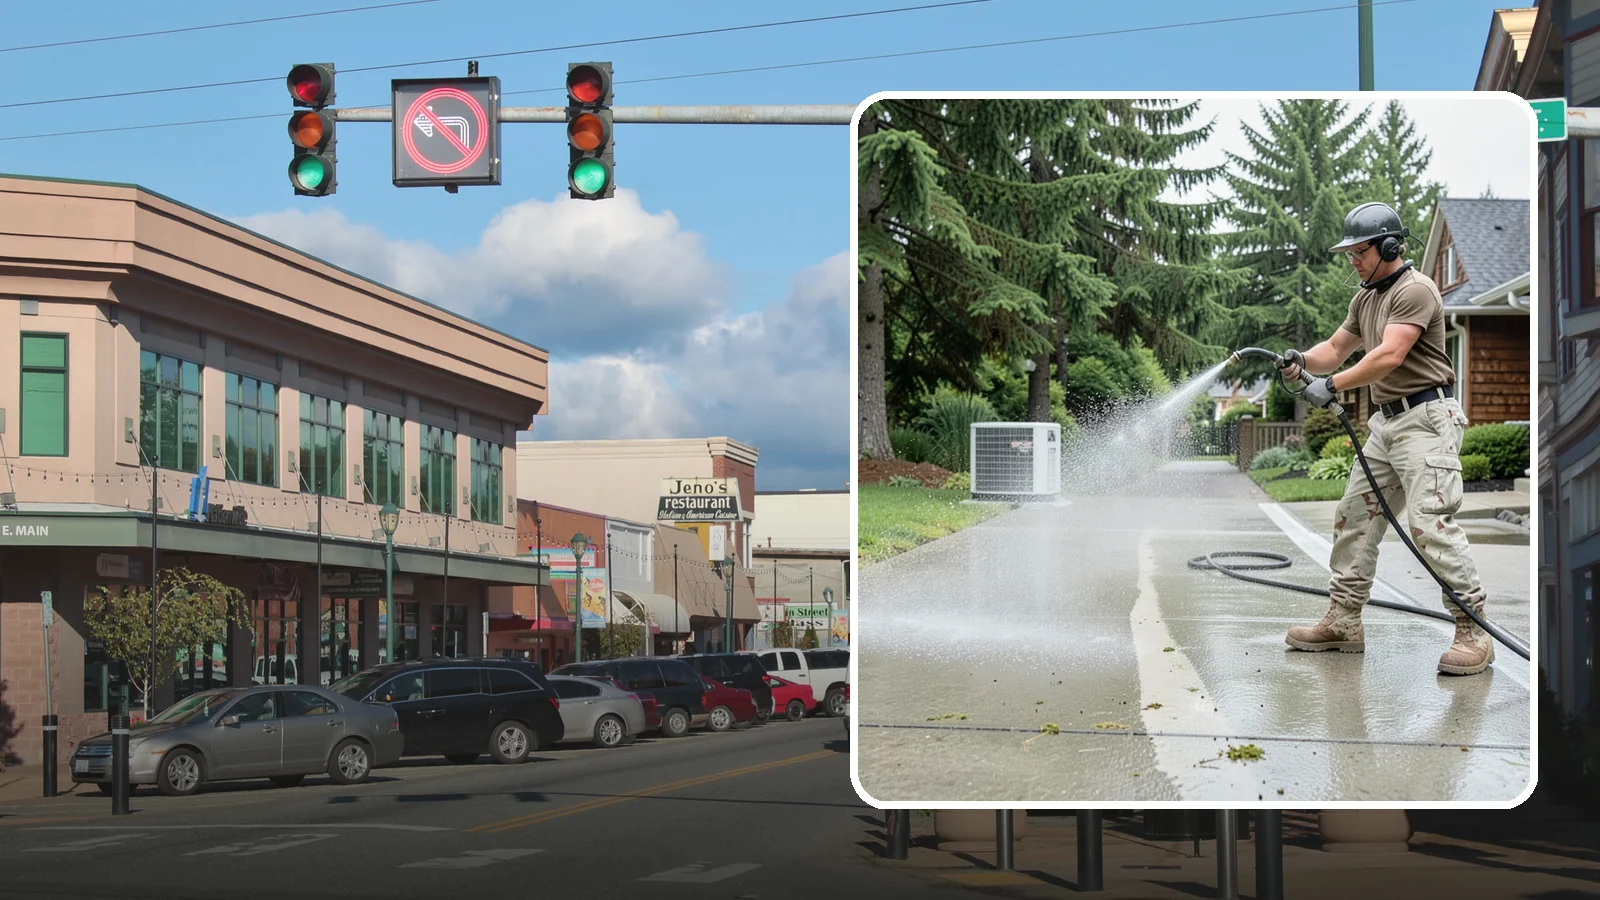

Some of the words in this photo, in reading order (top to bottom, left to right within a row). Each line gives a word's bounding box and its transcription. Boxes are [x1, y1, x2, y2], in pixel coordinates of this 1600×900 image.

[669, 480, 728, 494] Jeno's
[665, 496, 731, 509] restaurant
[658, 510, 681, 519] Italian
[686, 510, 714, 519] American
[715, 509, 738, 519] Cuisine
[2, 525, 13, 536] E.
[15, 525, 49, 536] MAIN
[797, 607, 829, 617] Street
